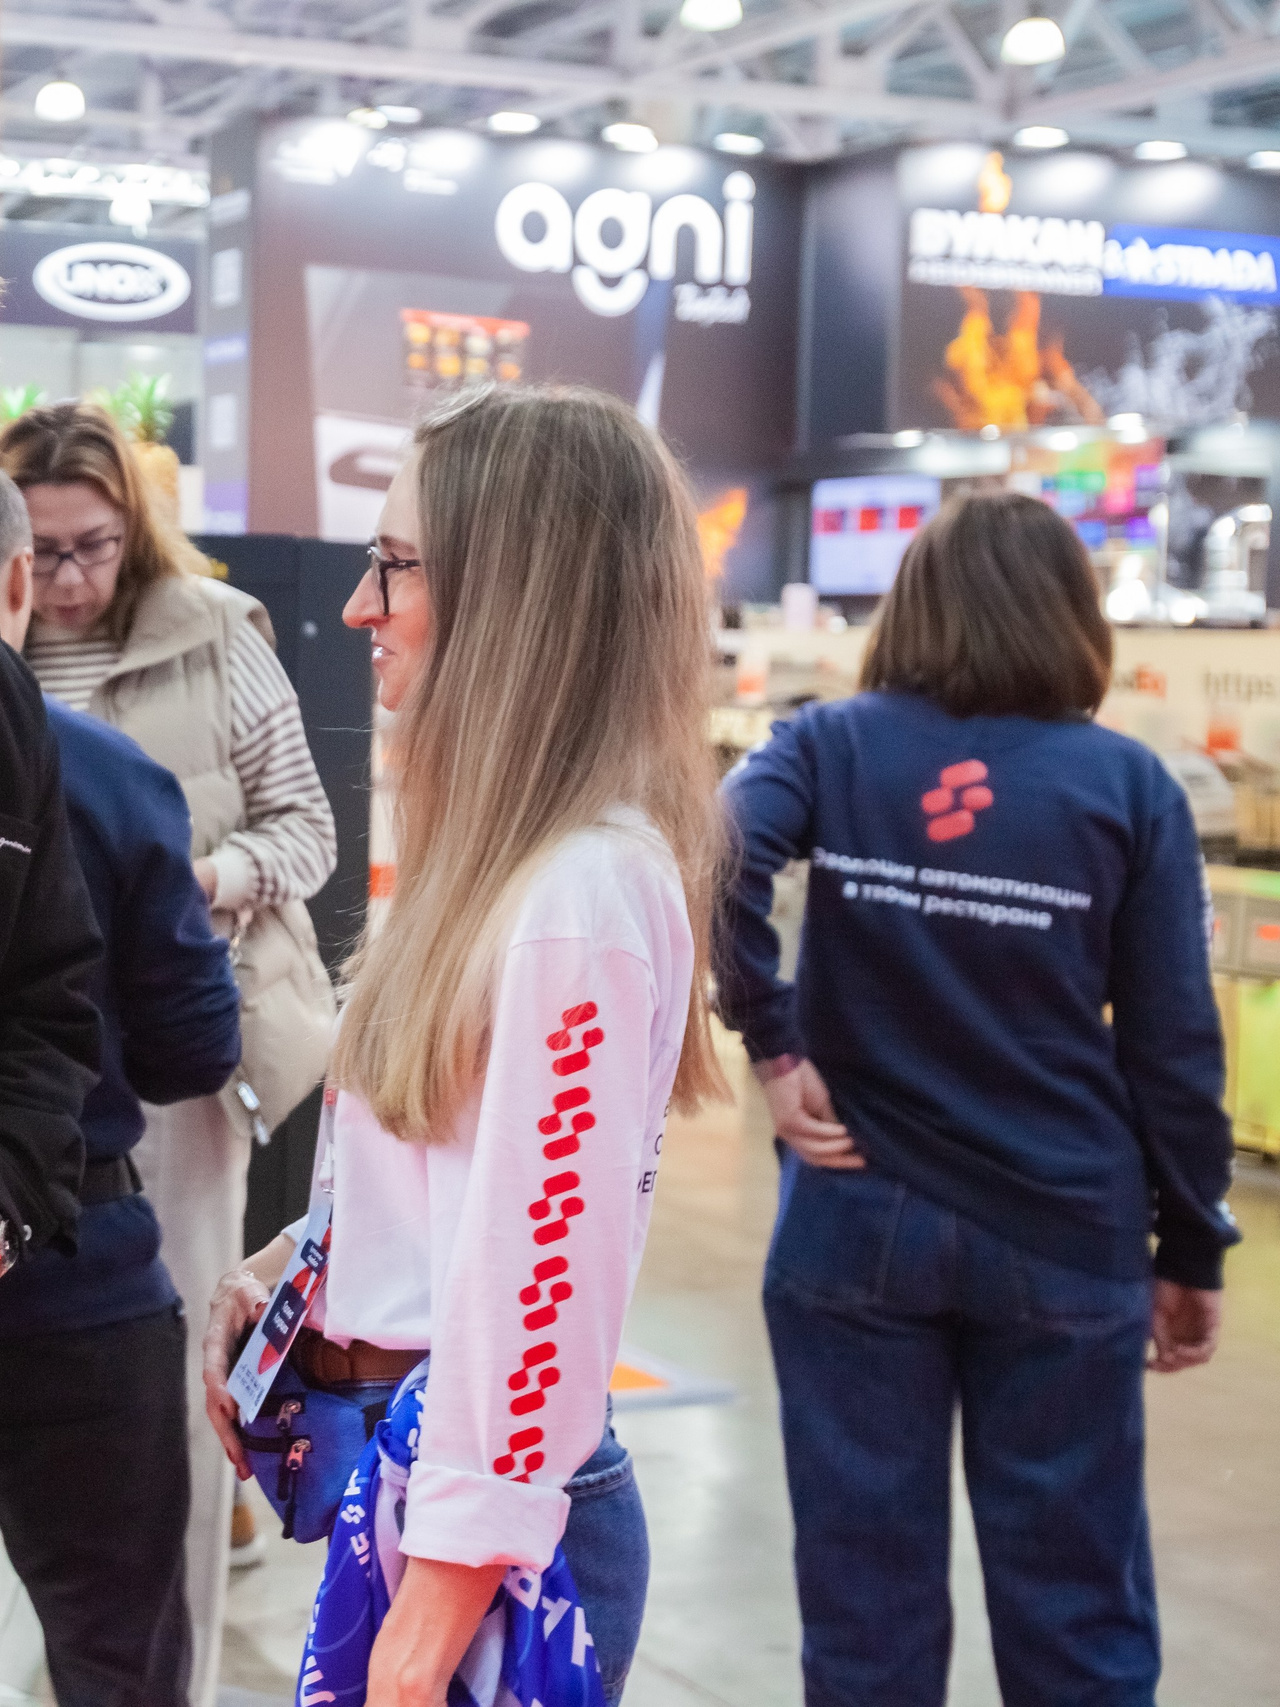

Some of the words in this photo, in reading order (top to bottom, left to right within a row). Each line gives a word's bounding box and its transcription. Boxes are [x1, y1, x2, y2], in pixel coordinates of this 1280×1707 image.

[495, 170, 756, 316] agni
[843, 881, 858, 900] в
[924, 894, 1053, 930] ресторане
